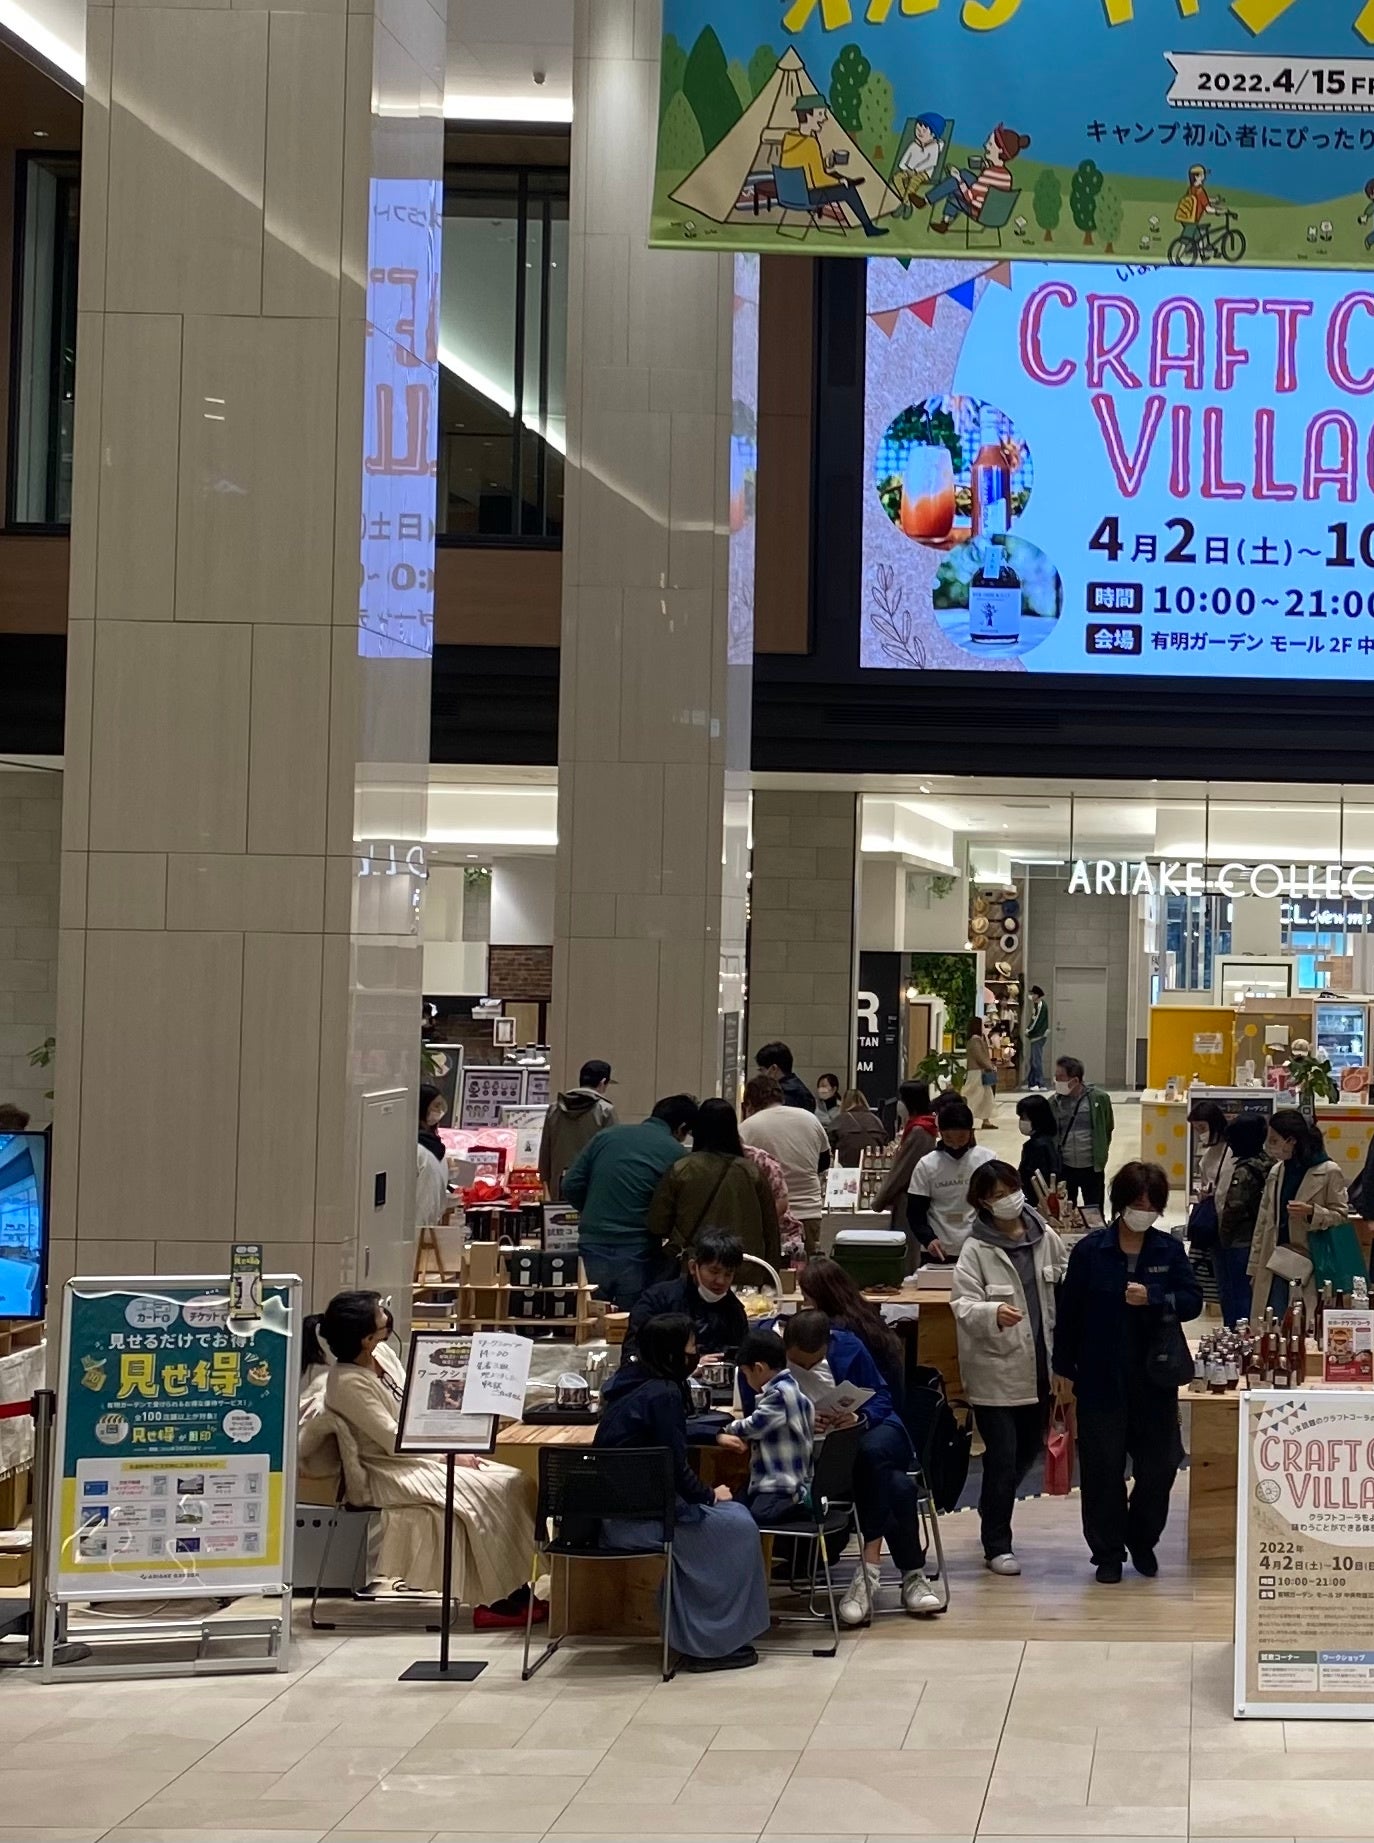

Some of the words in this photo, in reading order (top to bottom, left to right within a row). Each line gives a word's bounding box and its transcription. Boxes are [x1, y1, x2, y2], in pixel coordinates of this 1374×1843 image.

[1019, 281, 1315, 394] CRAFT
[1094, 588, 1134, 609] 時間
[1094, 628, 1134, 650] 会場
[1151, 631, 1264, 652] 有明ガーデン
[1269, 635, 1325, 653] モール
[1330, 637, 1353, 653] 2F
[1067, 859, 1206, 897] ARIAKE
[116, 1351, 242, 1399] 見せ得
[418, 1369, 467, 1379] ワークシ
[1259, 1435, 1363, 1473] CRAFT
[1259, 1541, 1304, 1554] 2022年
